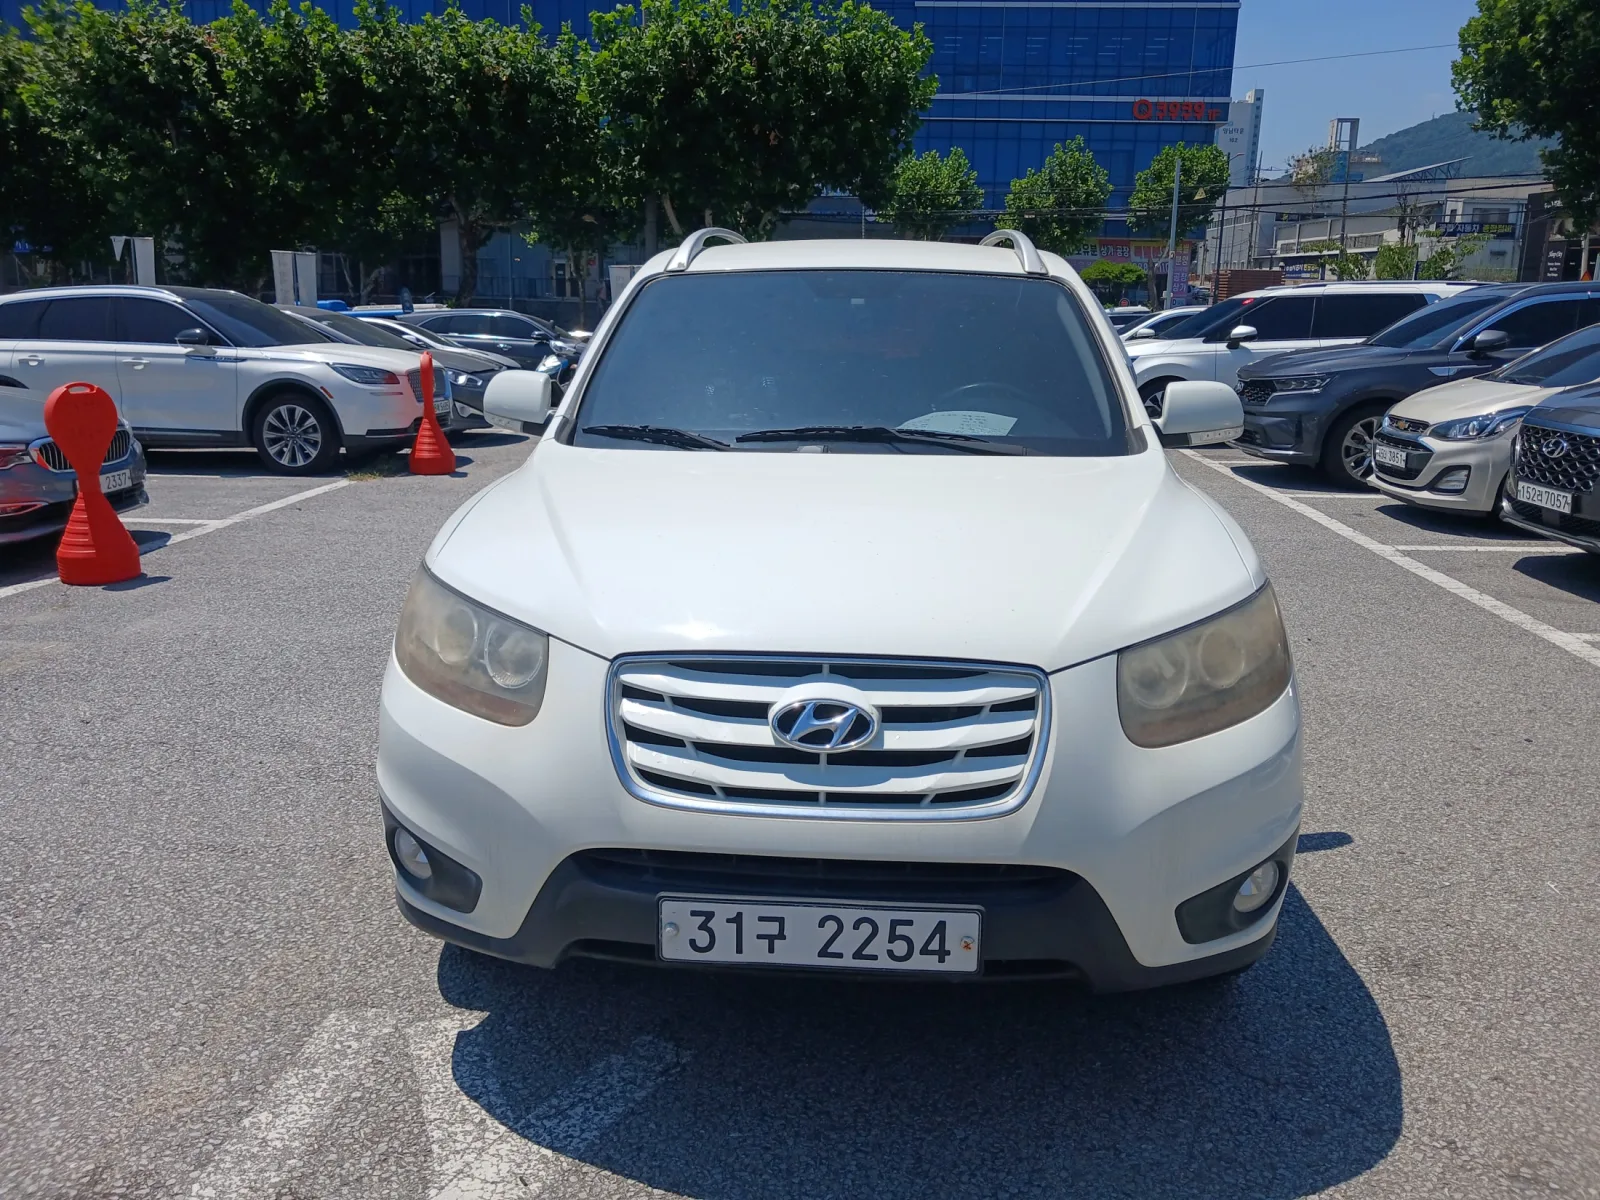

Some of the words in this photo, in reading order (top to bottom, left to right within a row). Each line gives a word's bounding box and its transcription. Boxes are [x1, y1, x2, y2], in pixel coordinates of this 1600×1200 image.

[1457, 223, 1480, 233] 자동차
[105, 472, 127, 490] 2337
[688, 909, 787, 955] 31구
[816, 914, 951, 964] 2254
